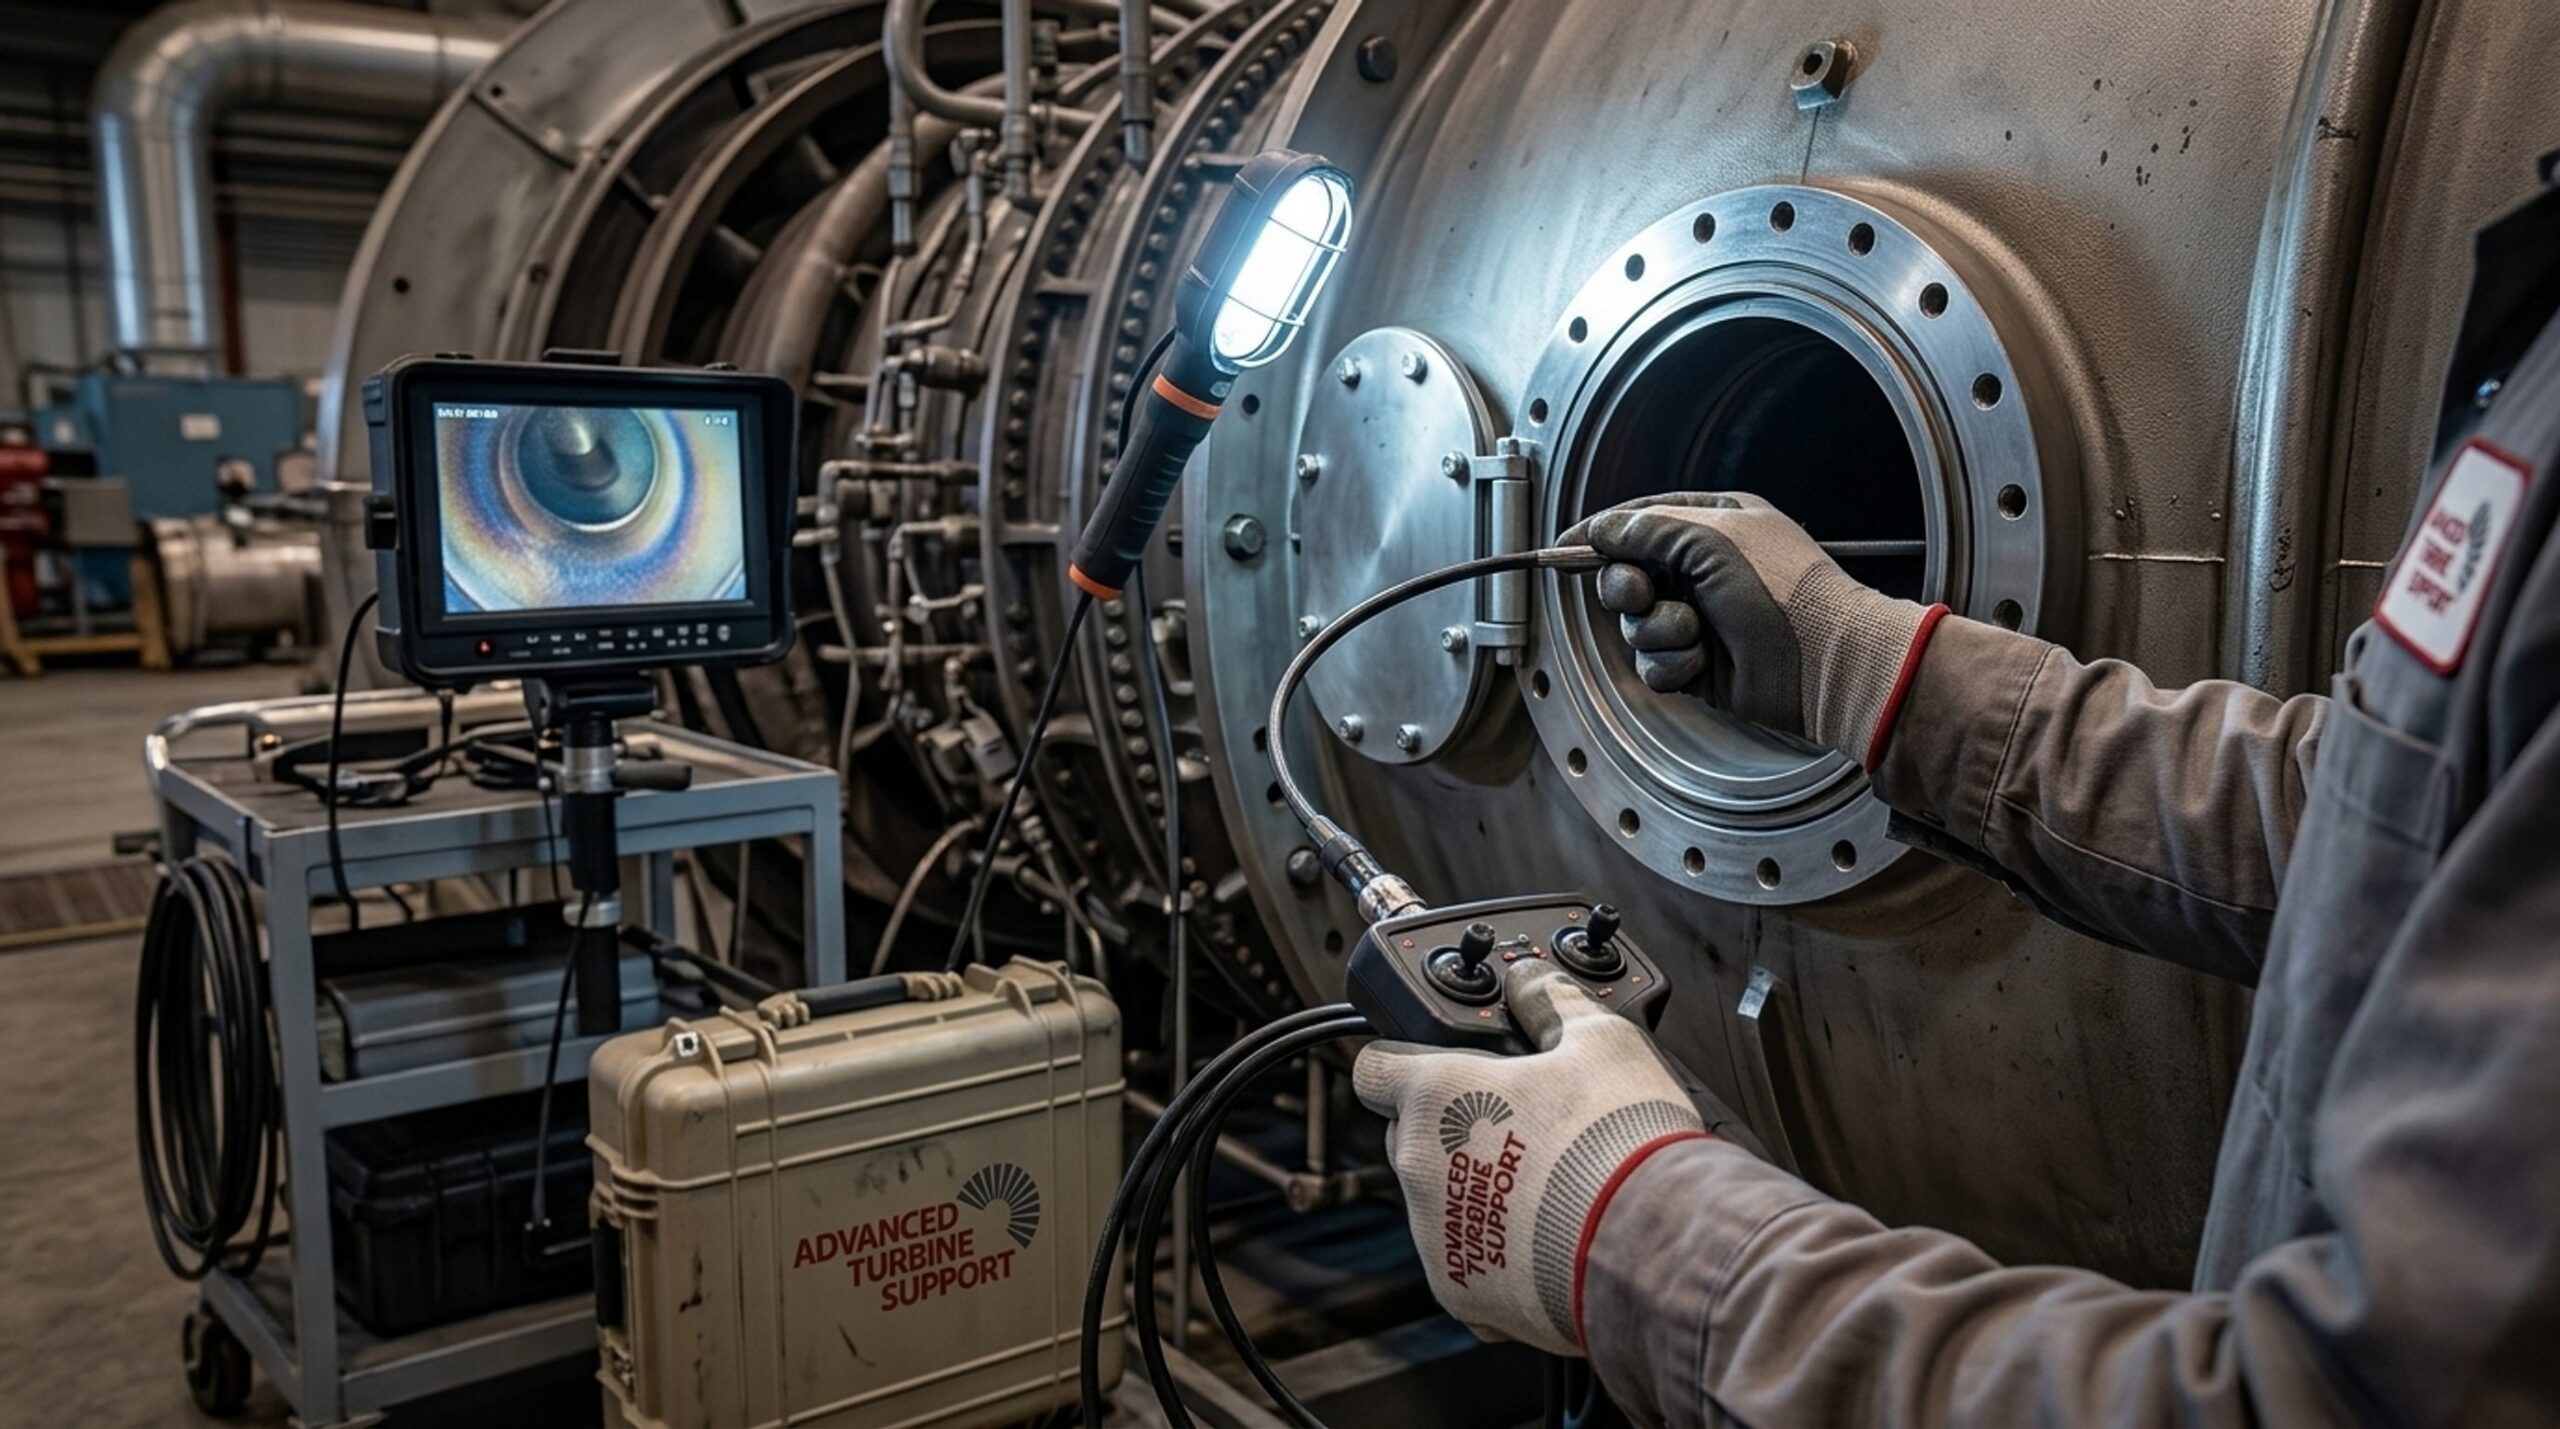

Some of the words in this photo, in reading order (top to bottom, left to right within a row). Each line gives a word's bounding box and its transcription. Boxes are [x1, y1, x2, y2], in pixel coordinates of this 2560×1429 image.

[1445, 1151, 1470, 1289] ADVANCED
[1487, 1130, 1527, 1269] SUPPORT
[794, 1202, 959, 1268] ADVANCED
[847, 1229, 974, 1287] TURBINE
[881, 1249, 1016, 1312] SUPPORT
